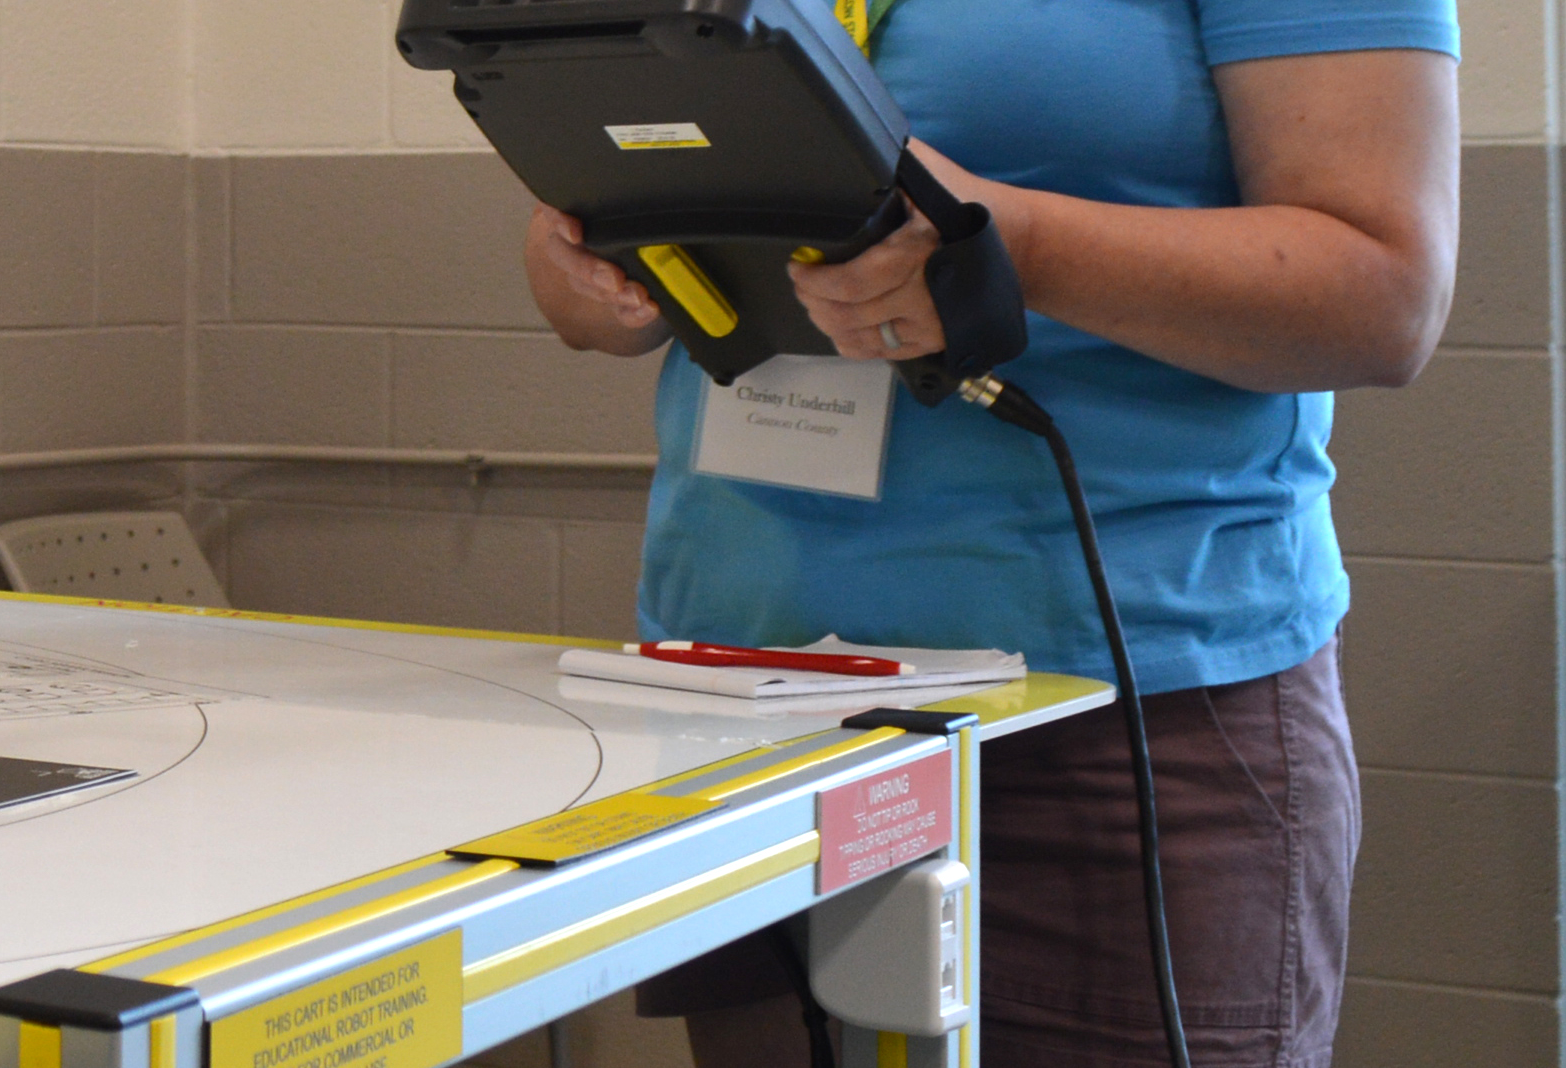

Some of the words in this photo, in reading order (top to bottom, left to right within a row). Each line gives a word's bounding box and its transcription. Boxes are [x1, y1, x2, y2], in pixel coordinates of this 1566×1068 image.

[737, 385, 785, 408] Christy
[788, 393, 856, 416] Underhill
[747, 411, 792, 429] Cannon
[795, 418, 840, 437] County
[869, 773, 910, 805] WARNING
[838, 838, 864, 858] TIPPING
[865, 835, 874, 852] OR
[875, 824, 903, 846] ROCKING
[904, 820, 915, 836] MAY
[917, 810, 937, 831] CAUSE
[857, 816, 866, 834] DO
[867, 811, 880, 828] NOT
[880, 808, 891, 825] TIP
[892, 805, 901, 821] OR
[902, 798, 919, 817] ROCK
[848, 854, 875, 878] SERIOUS
[265, 1011, 292, 1039] THIS
[294, 998, 325, 1028] CART
[328, 993, 338, 1015] IS
[341, 971, 395, 1008] INTENDED
[397, 961, 420, 987] FOR
[253, 1025, 334, 1068] EDUCATIONAL
[336, 1007, 375, 1040] ROBOT
[378, 986, 429, 1020] TRAINING.
[324, 1027, 396, 1068] COMMERCIAL
[399, 1018, 415, 1040] OR
